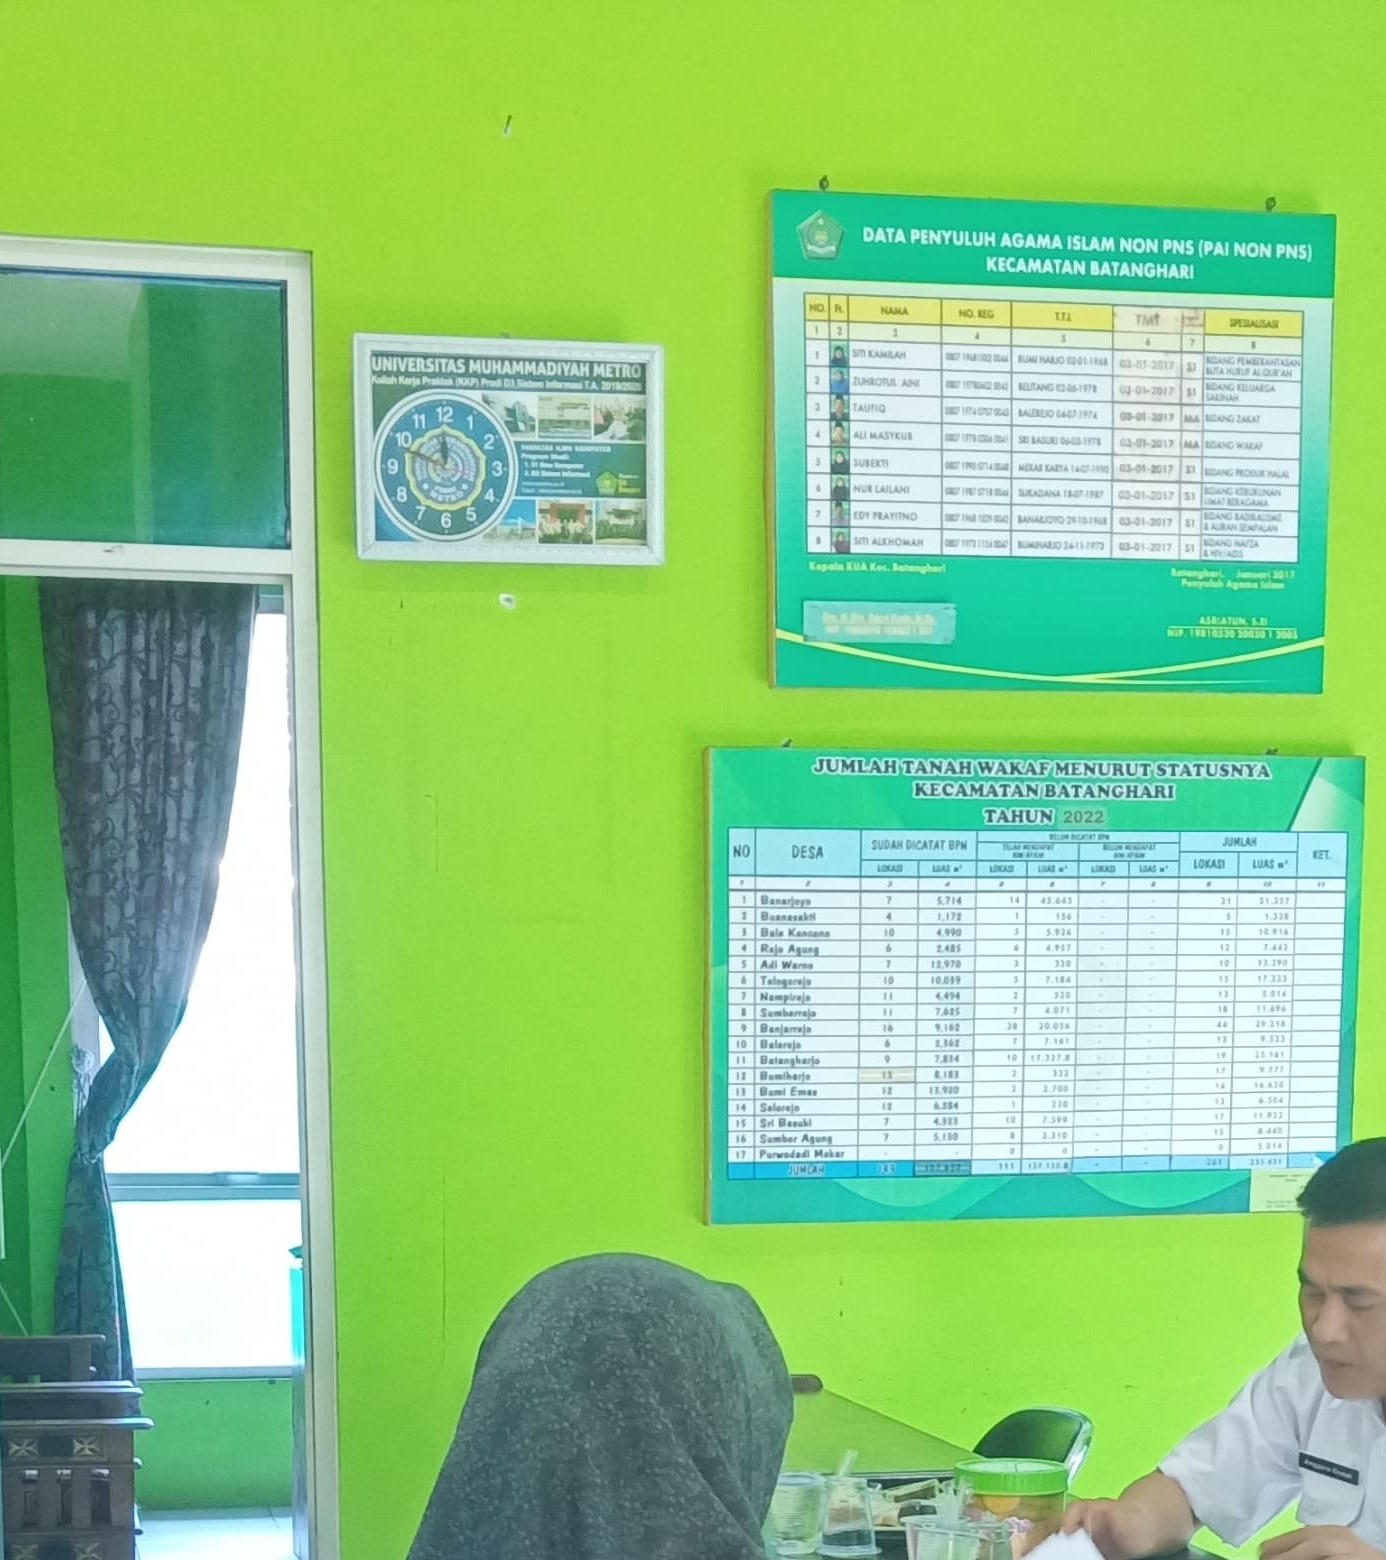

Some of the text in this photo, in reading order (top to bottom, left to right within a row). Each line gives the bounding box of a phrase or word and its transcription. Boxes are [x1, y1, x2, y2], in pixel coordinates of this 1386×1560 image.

[863, 227, 1313, 262] DATA PENYULUH AGAMA ISLAM NON PNS (PAI NON PNS)
[986, 256, 1194, 280] KECAMATAN BATANGHARI
[881, 306, 909, 316] NAMA
[372, 356, 641, 379] UNIVERSITAS MUHAMMADIYAH METRO
[436, 406, 453, 423] 12
[853, 403, 886, 414] TAUFIQ
[413, 414, 426, 429] 11
[466, 415, 473, 430] 1
[395, 432, 412, 448] 10
[484, 435, 494, 450] 2
[387, 459, 398, 474] 9
[492, 461, 502, 477] 3
[815, 457, 820, 466] 5
[853, 457, 889, 469] SUBEKTI
[397, 487, 407, 502] 8
[485, 488, 495, 503] 4
[816, 484, 821, 493] 6
[416, 506, 426, 521] 7
[441, 513, 451, 528] 6
[466, 507, 477, 521] 5
[816, 510, 821, 519] 7
[1119, 517, 1172, 528] 03-01-2017
[816, 536, 821, 545] 8
[1119, 542, 1172, 552] 03-01-2017
[847, 562, 868, 571] KUA
[814, 758, 1270, 778] JUMLAH TANAH WAKAF MENURUT STATUSNYA
[914, 782, 1175, 799] KECAMATAN BATANGHARI
[984, 809, 1104, 824] TAHUN 2022
[733, 837, 1332, 860] NO DESA SUDAH DICATAT BPN JUMLAH KET.
[1194, 859, 1225, 869] LOKASI
[1253, 860, 1274, 869] LUAS
[887, 896, 892, 904] 7
[884, 928, 894, 937] 10
[742, 944, 746, 952] 4
[742, 960, 746, 968] 5
[886, 960, 891, 968] 7
[884, 976, 894, 984] 10
[741, 992, 746, 1000] 7
[736, 1040, 746, 1048] 10
[736, 1103, 746, 1112] 14
[736, 1119, 746, 1128] 15
[736, 1135, 746, 1143] 16
[736, 1151, 746, 1159] 17
